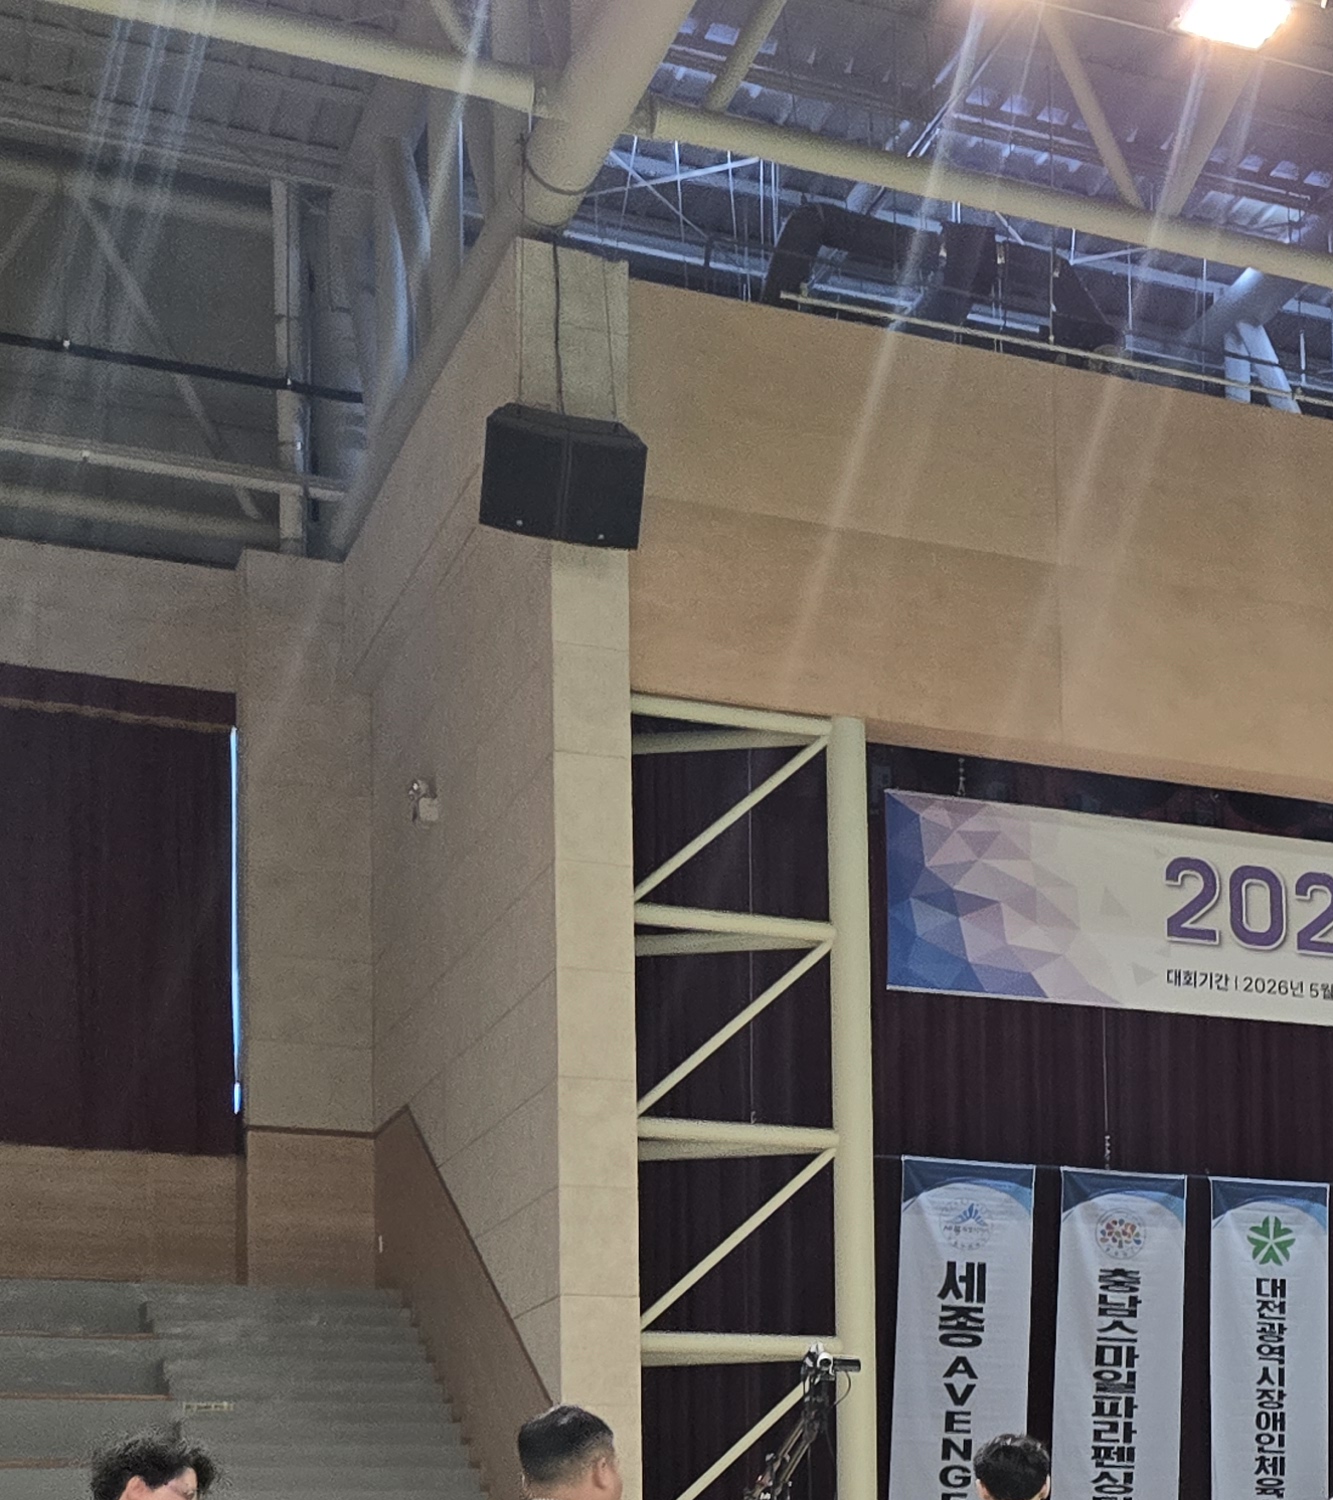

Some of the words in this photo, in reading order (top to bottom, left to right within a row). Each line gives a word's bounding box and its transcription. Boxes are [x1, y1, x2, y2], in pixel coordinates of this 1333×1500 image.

[1166, 969, 1229, 992] 대회기간
[1243, 976, 1304, 998] 2026년
[937, 1261, 987, 1348] 세종
